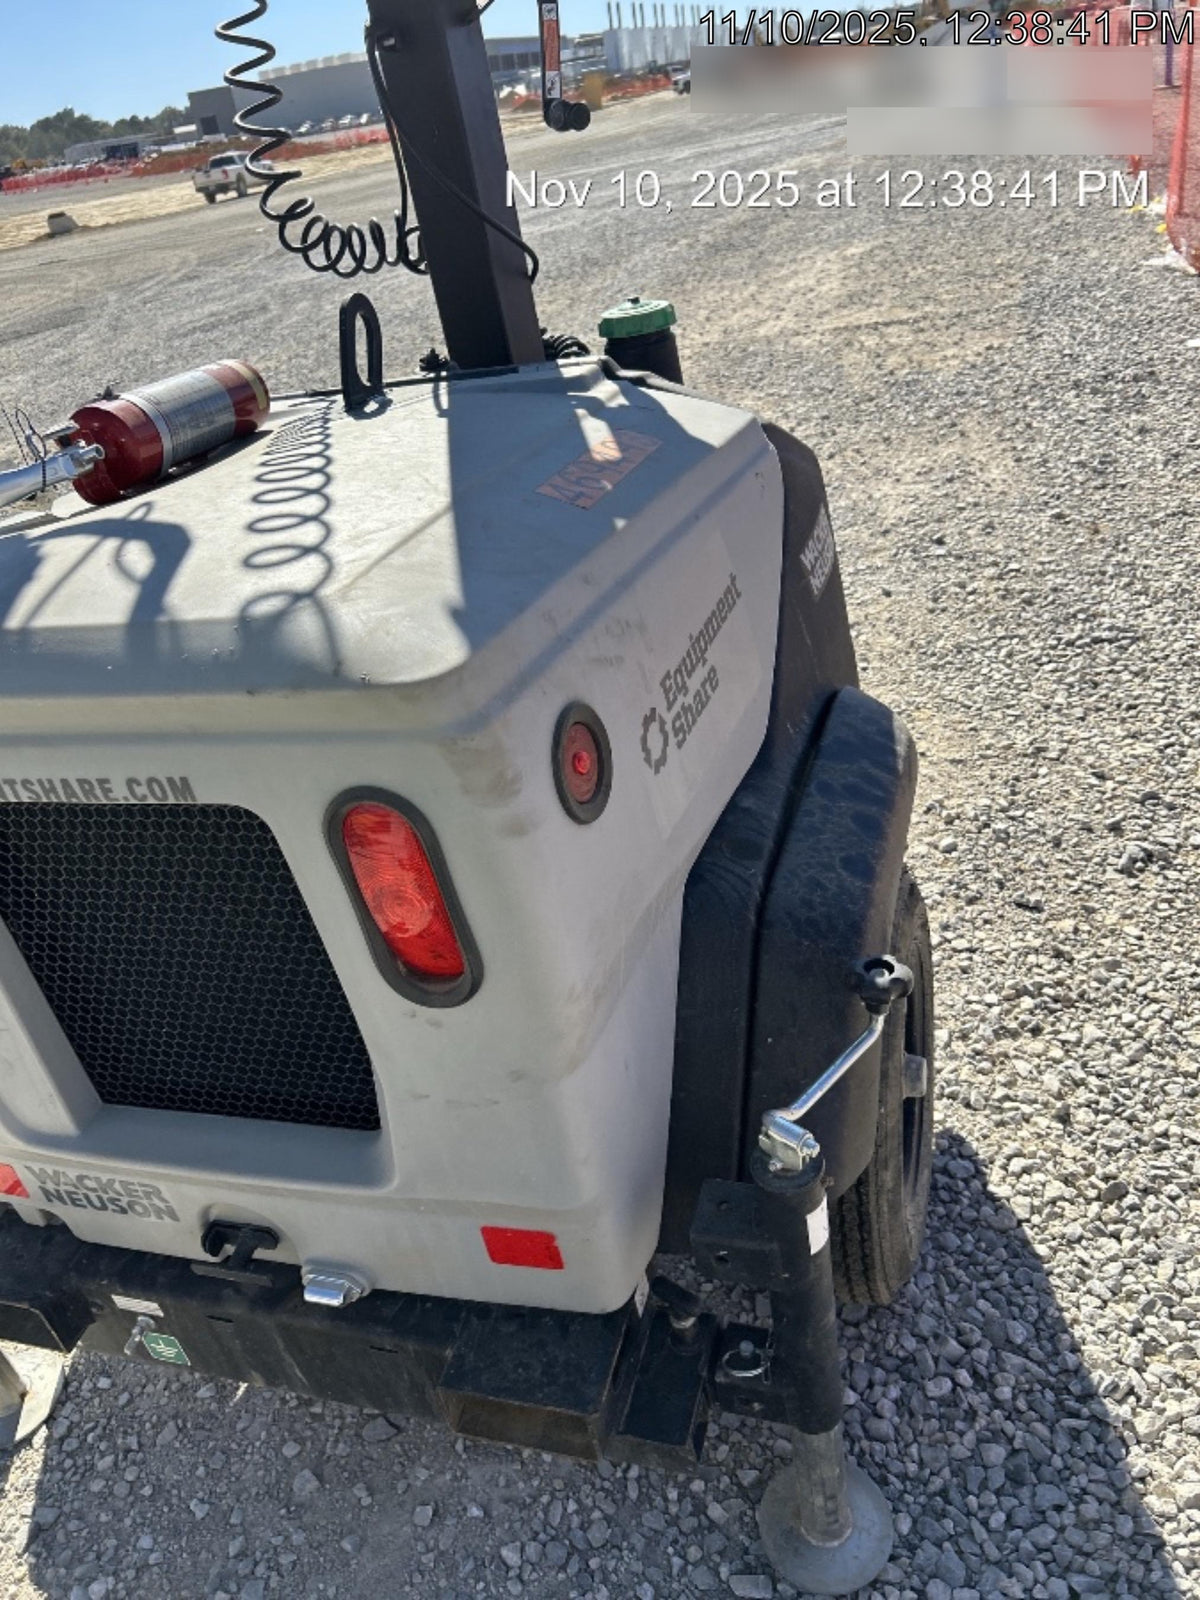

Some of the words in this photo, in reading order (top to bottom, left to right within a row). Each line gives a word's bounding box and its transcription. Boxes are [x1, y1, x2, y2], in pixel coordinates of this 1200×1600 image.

[660, 572, 742, 712] Equipment
[671, 664, 720, 750] Share
[25, 1165, 170, 1205] WACKER
[39, 1186, 181, 1222] NEUSON
